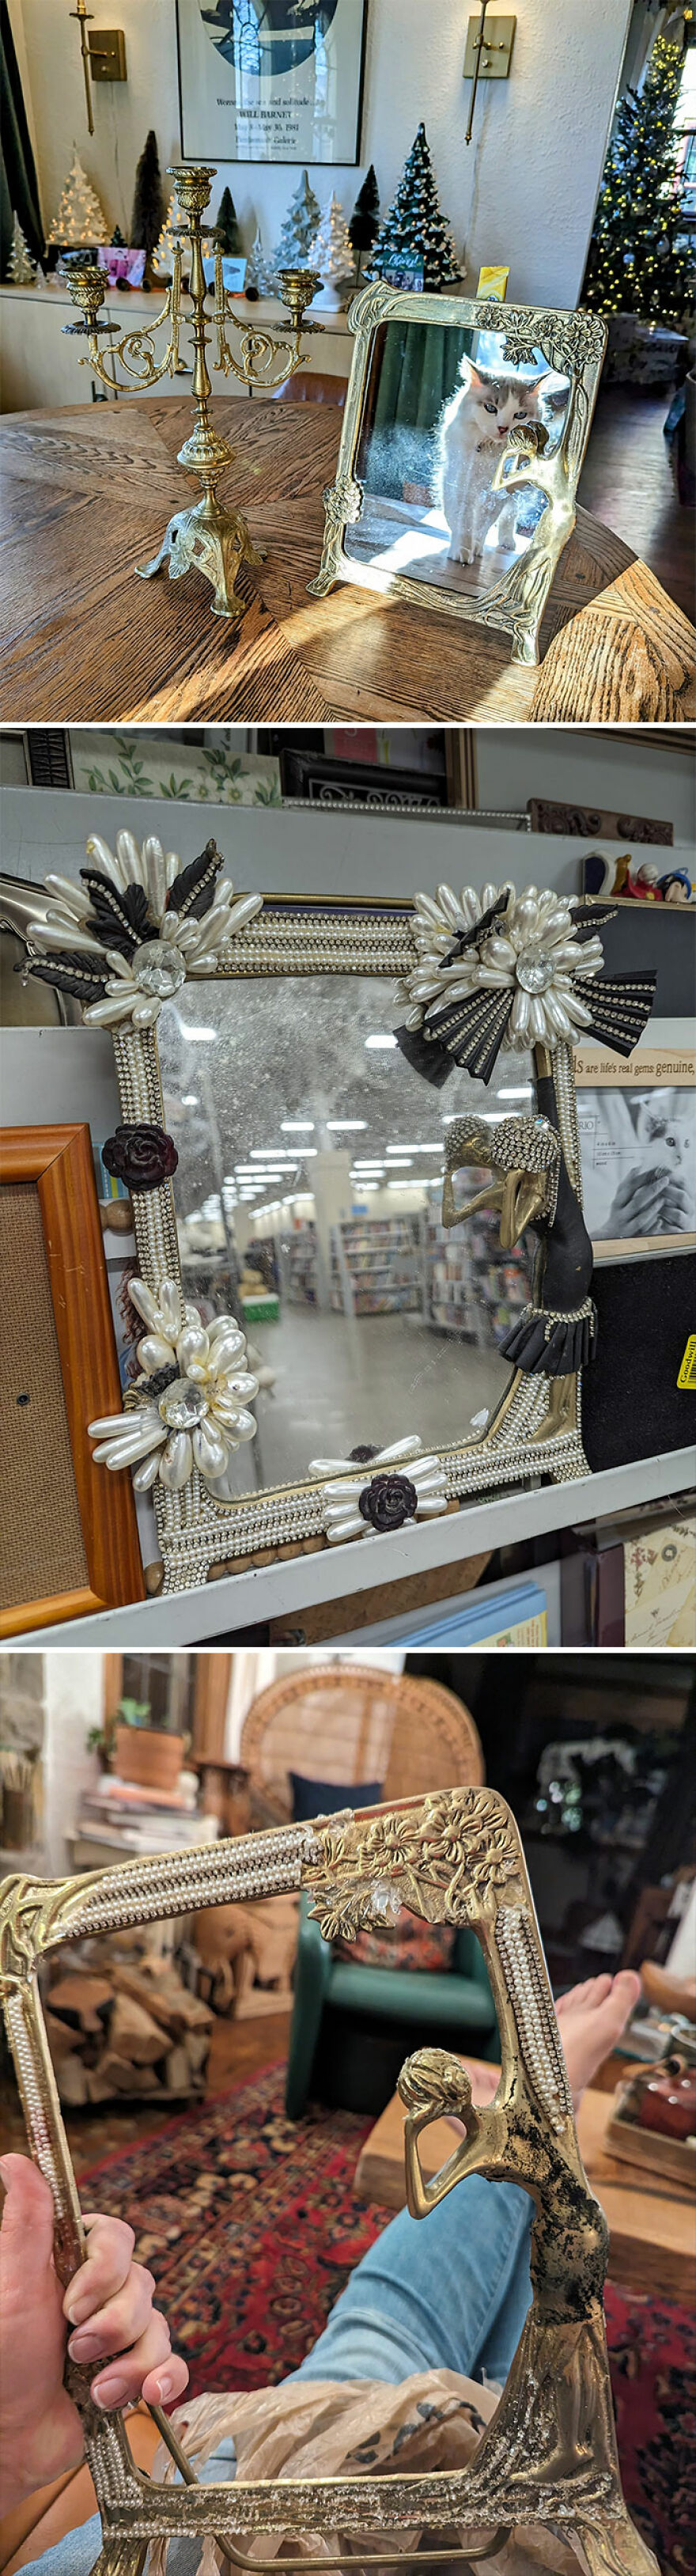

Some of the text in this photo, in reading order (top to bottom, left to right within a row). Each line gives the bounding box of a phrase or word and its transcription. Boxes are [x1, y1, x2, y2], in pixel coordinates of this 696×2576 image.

[585, 1064, 599, 1074] are
[600, 1063, 617, 1074] life's
[618, 1063, 633, 1074] real
[656, 1060, 695, 1077] genuine,
[680, 1341, 696, 1383] Goodwill
